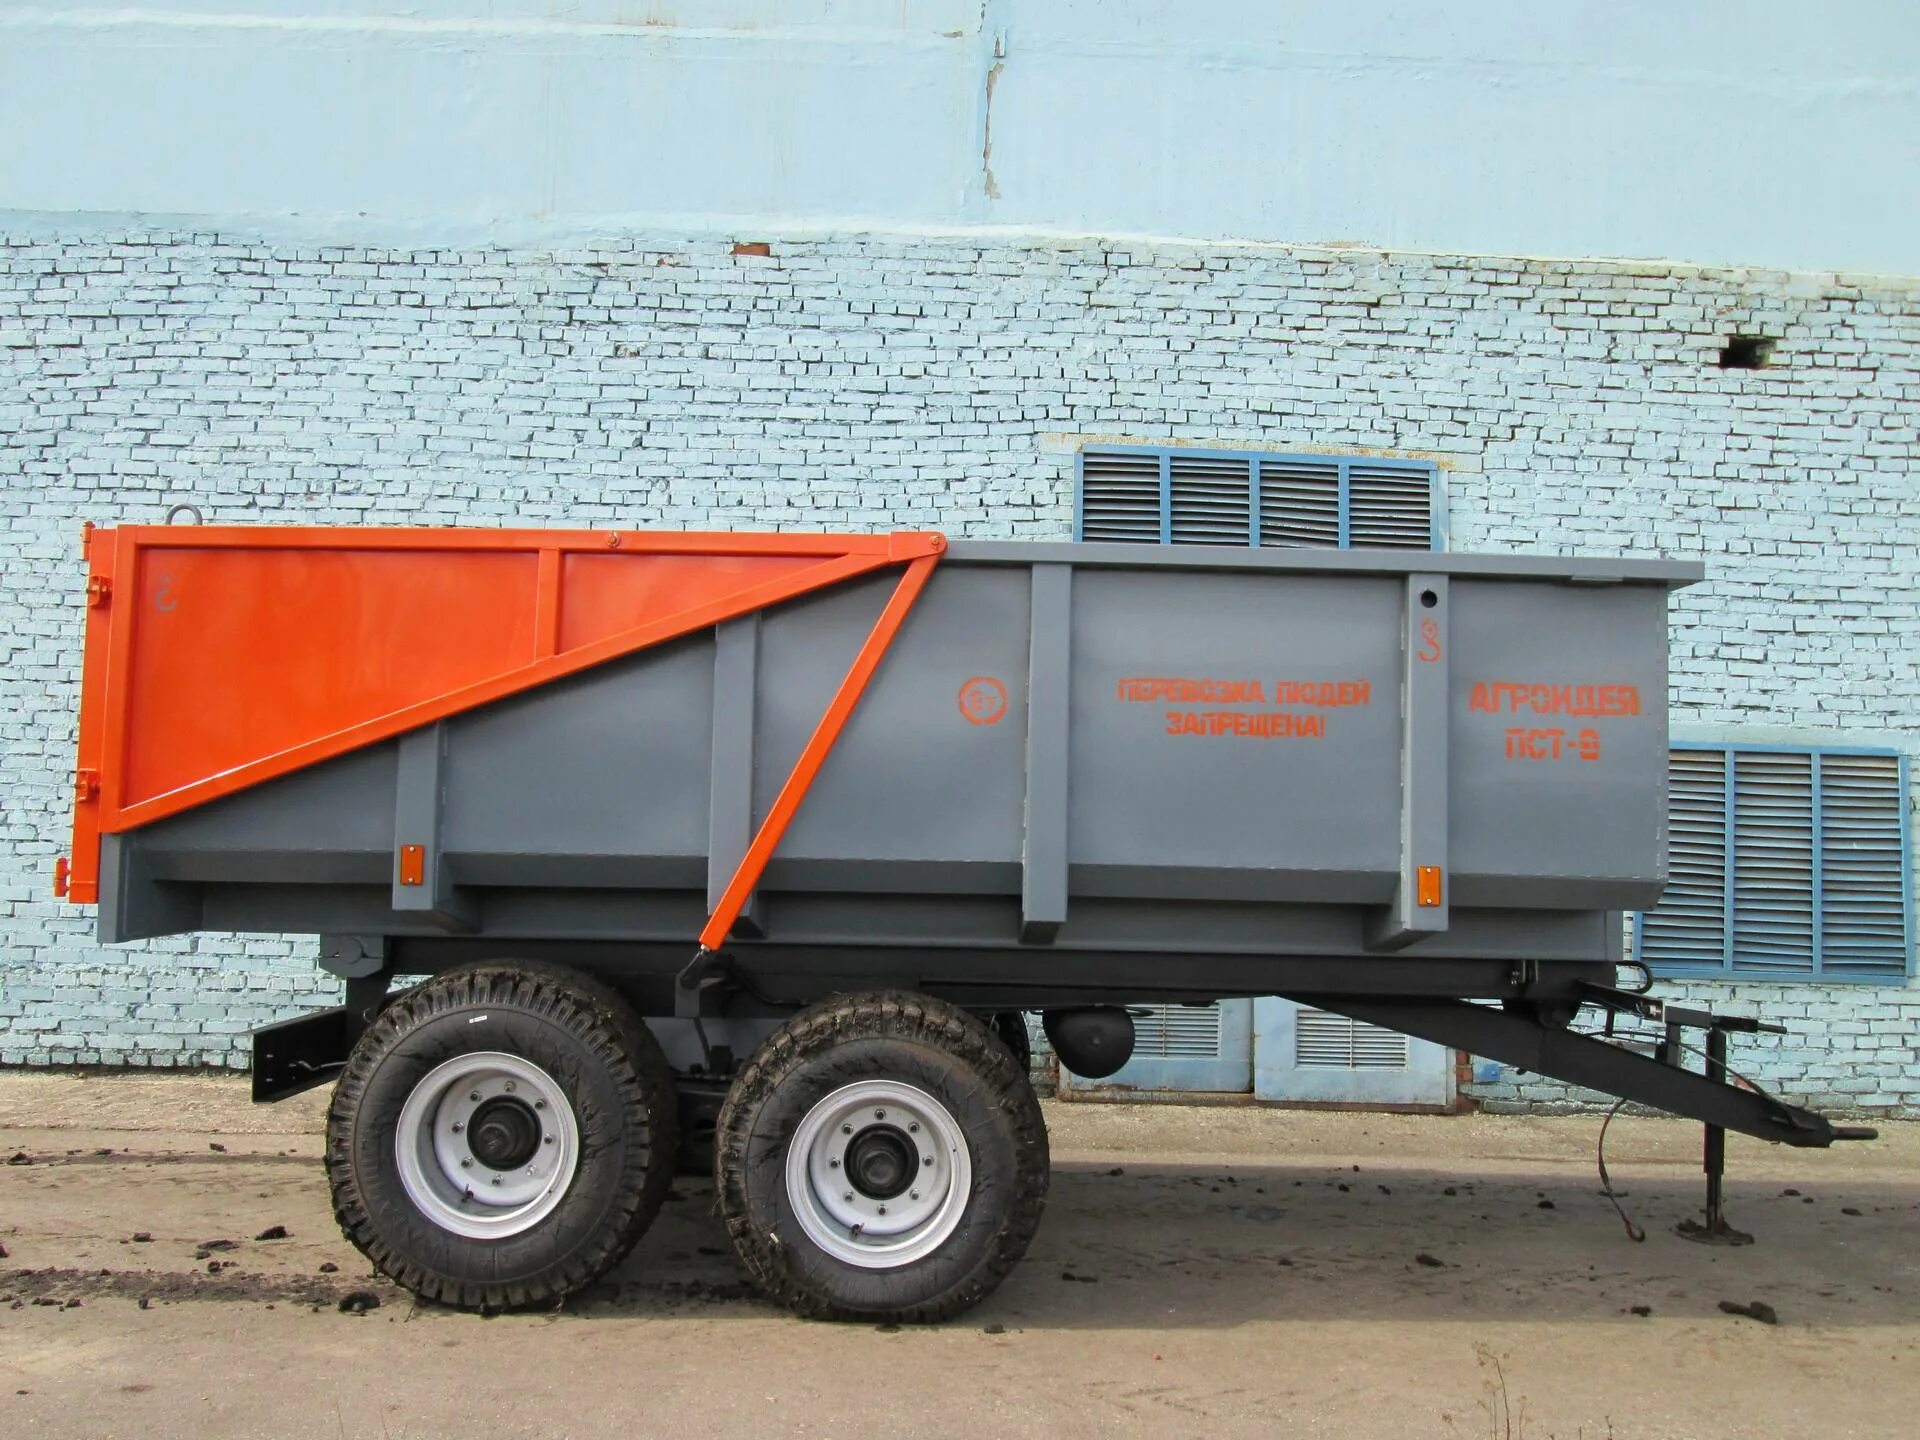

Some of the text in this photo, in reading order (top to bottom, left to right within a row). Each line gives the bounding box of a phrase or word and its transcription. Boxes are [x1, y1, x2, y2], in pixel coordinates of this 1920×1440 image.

[1117, 678, 1371, 708] ПЕРЕВОЗКА ЛЮДЕЙ
[1469, 681, 1641, 718] АГРОИДЕЯ
[1166, 712, 1326, 738] ЗАПРЕЩЕНА!
